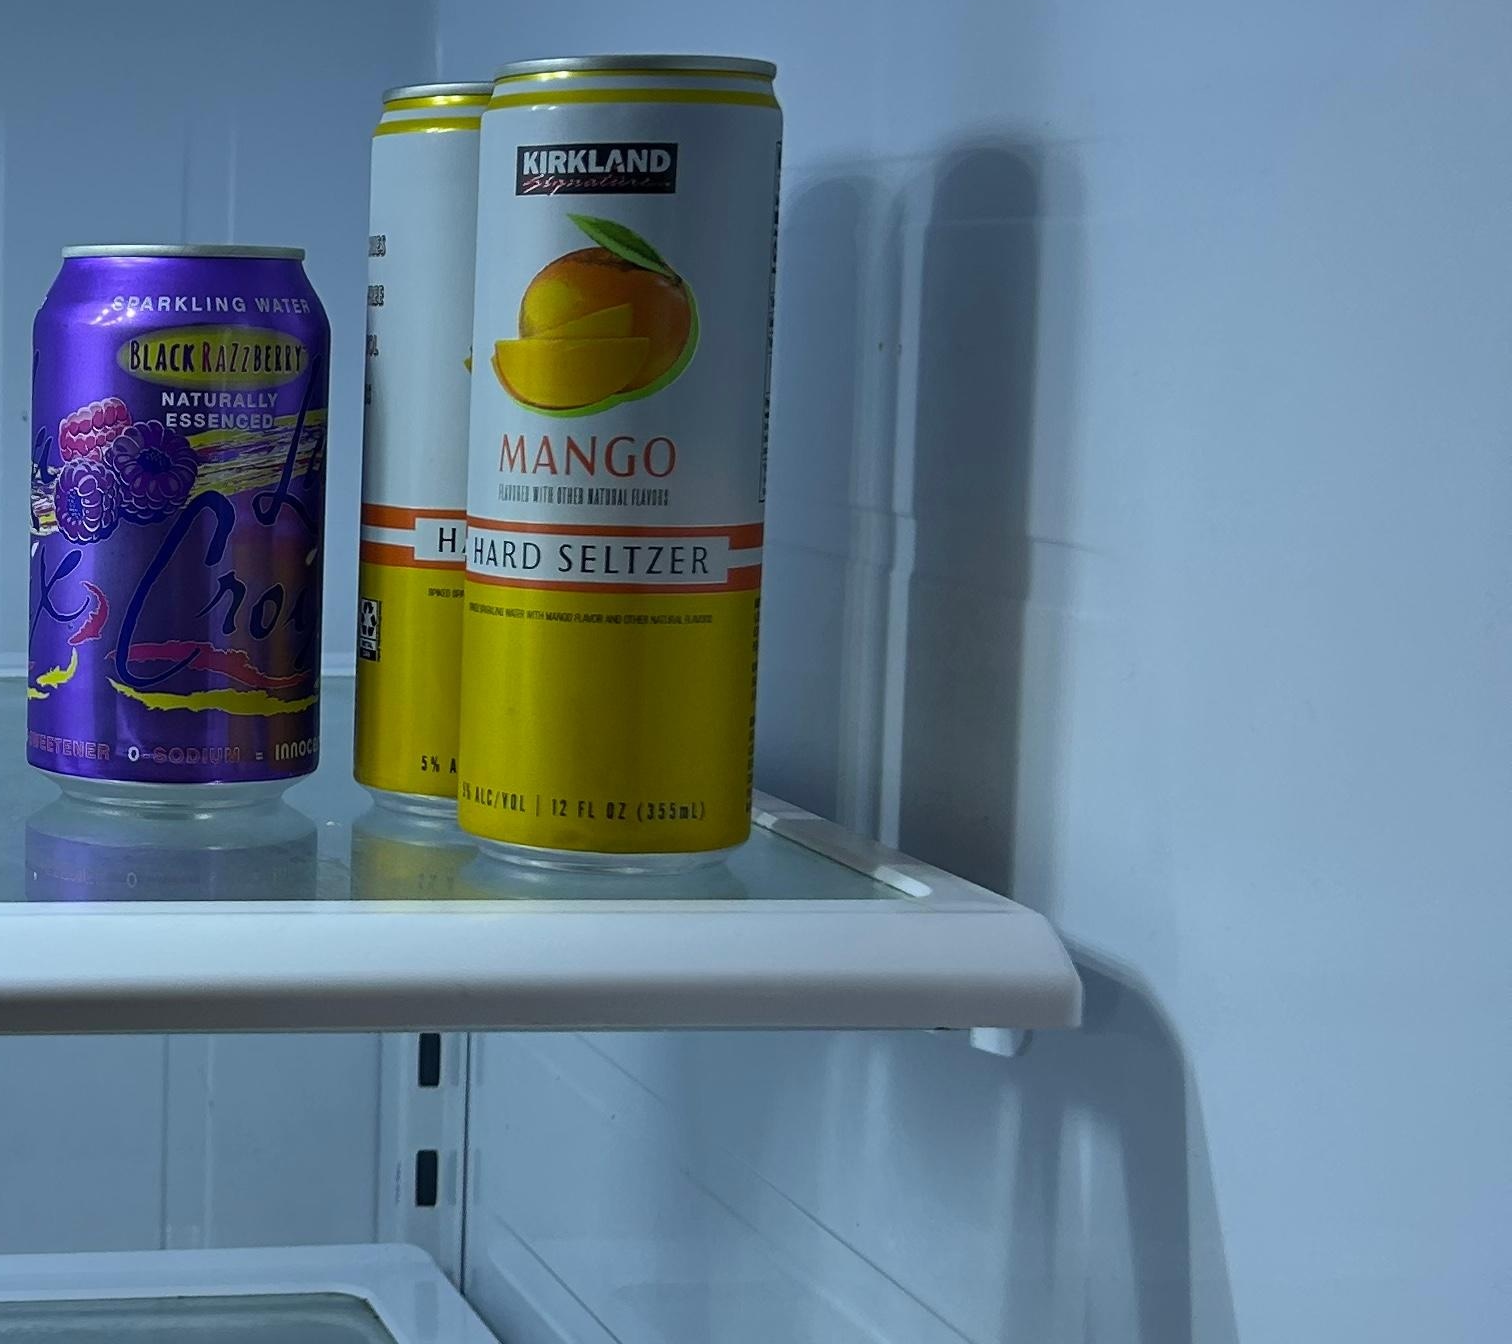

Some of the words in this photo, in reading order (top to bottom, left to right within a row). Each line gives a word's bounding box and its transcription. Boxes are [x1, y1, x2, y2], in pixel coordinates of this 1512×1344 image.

[523, 149, 672, 175] KIRKLAND
[112, 295, 247, 312] SPARKLING
[254, 297, 311, 314] WATER
[129, 339, 195, 373] BLACK
[161, 391, 279, 407] NATURALLY
[166, 412, 274, 429] ESSENCED
[498, 434, 676, 478] MANGO
[532, 485, 554, 504] WITH
[557, 486, 584, 505] OTHER
[587, 487, 628, 506] NATURAL
[631, 488, 669, 506] FLAVORS
[473, 536, 542, 570] HARD
[558, 543, 709, 575] SELTZER
[421, 754, 441, 773] 5%
[474, 785, 526, 813] ALC/VOL
[551, 798, 568, 817] 12
[577, 800, 595, 819] FL
[605, 801, 626, 820] OZ
[636, 801, 706, 823] (355mL)
